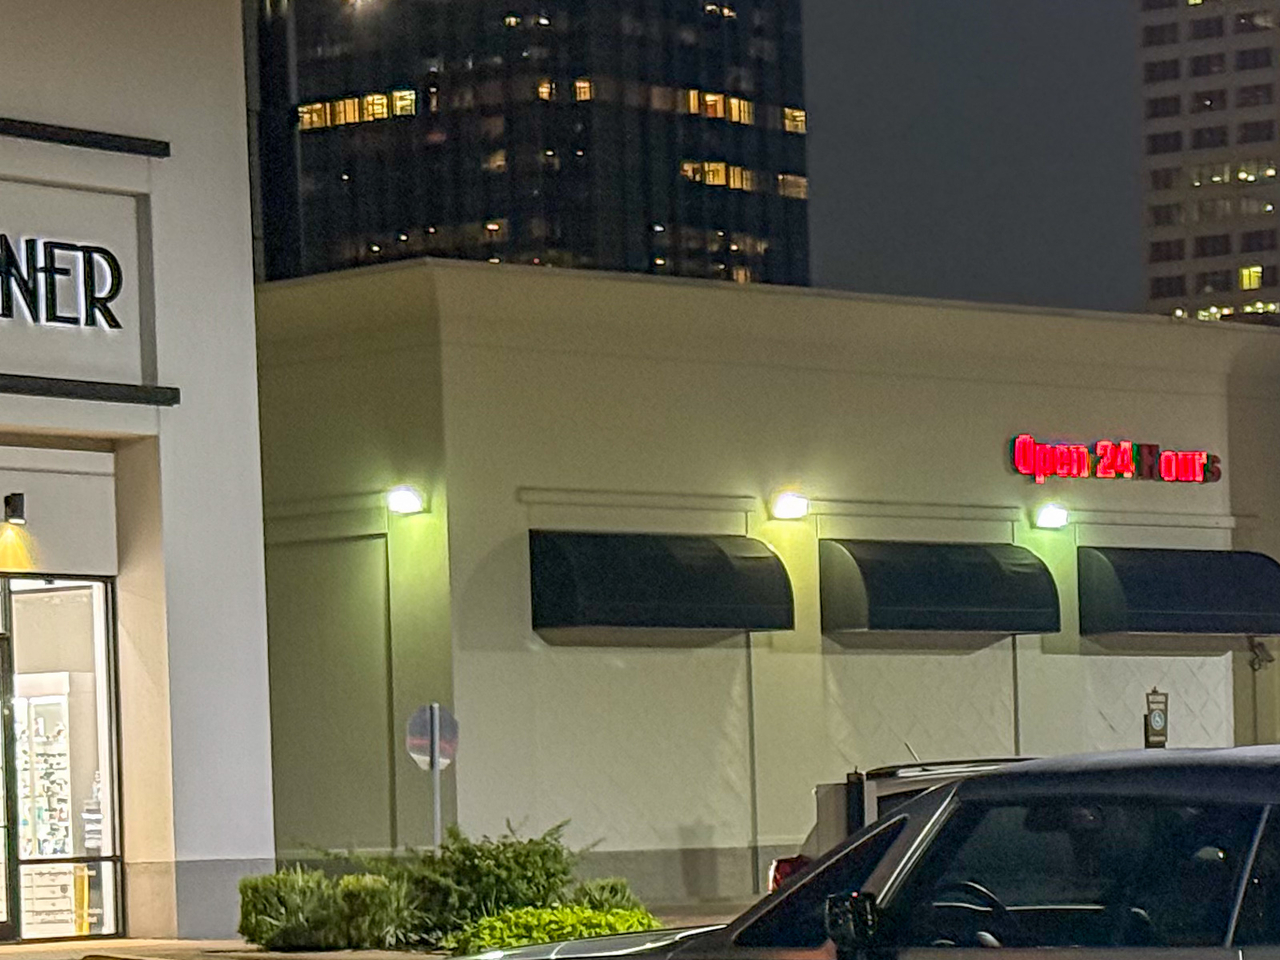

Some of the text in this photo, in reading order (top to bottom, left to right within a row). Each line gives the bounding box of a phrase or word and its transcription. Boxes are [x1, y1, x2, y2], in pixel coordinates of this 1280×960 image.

[1013, 434, 1222, 484] Open 24 Hours
